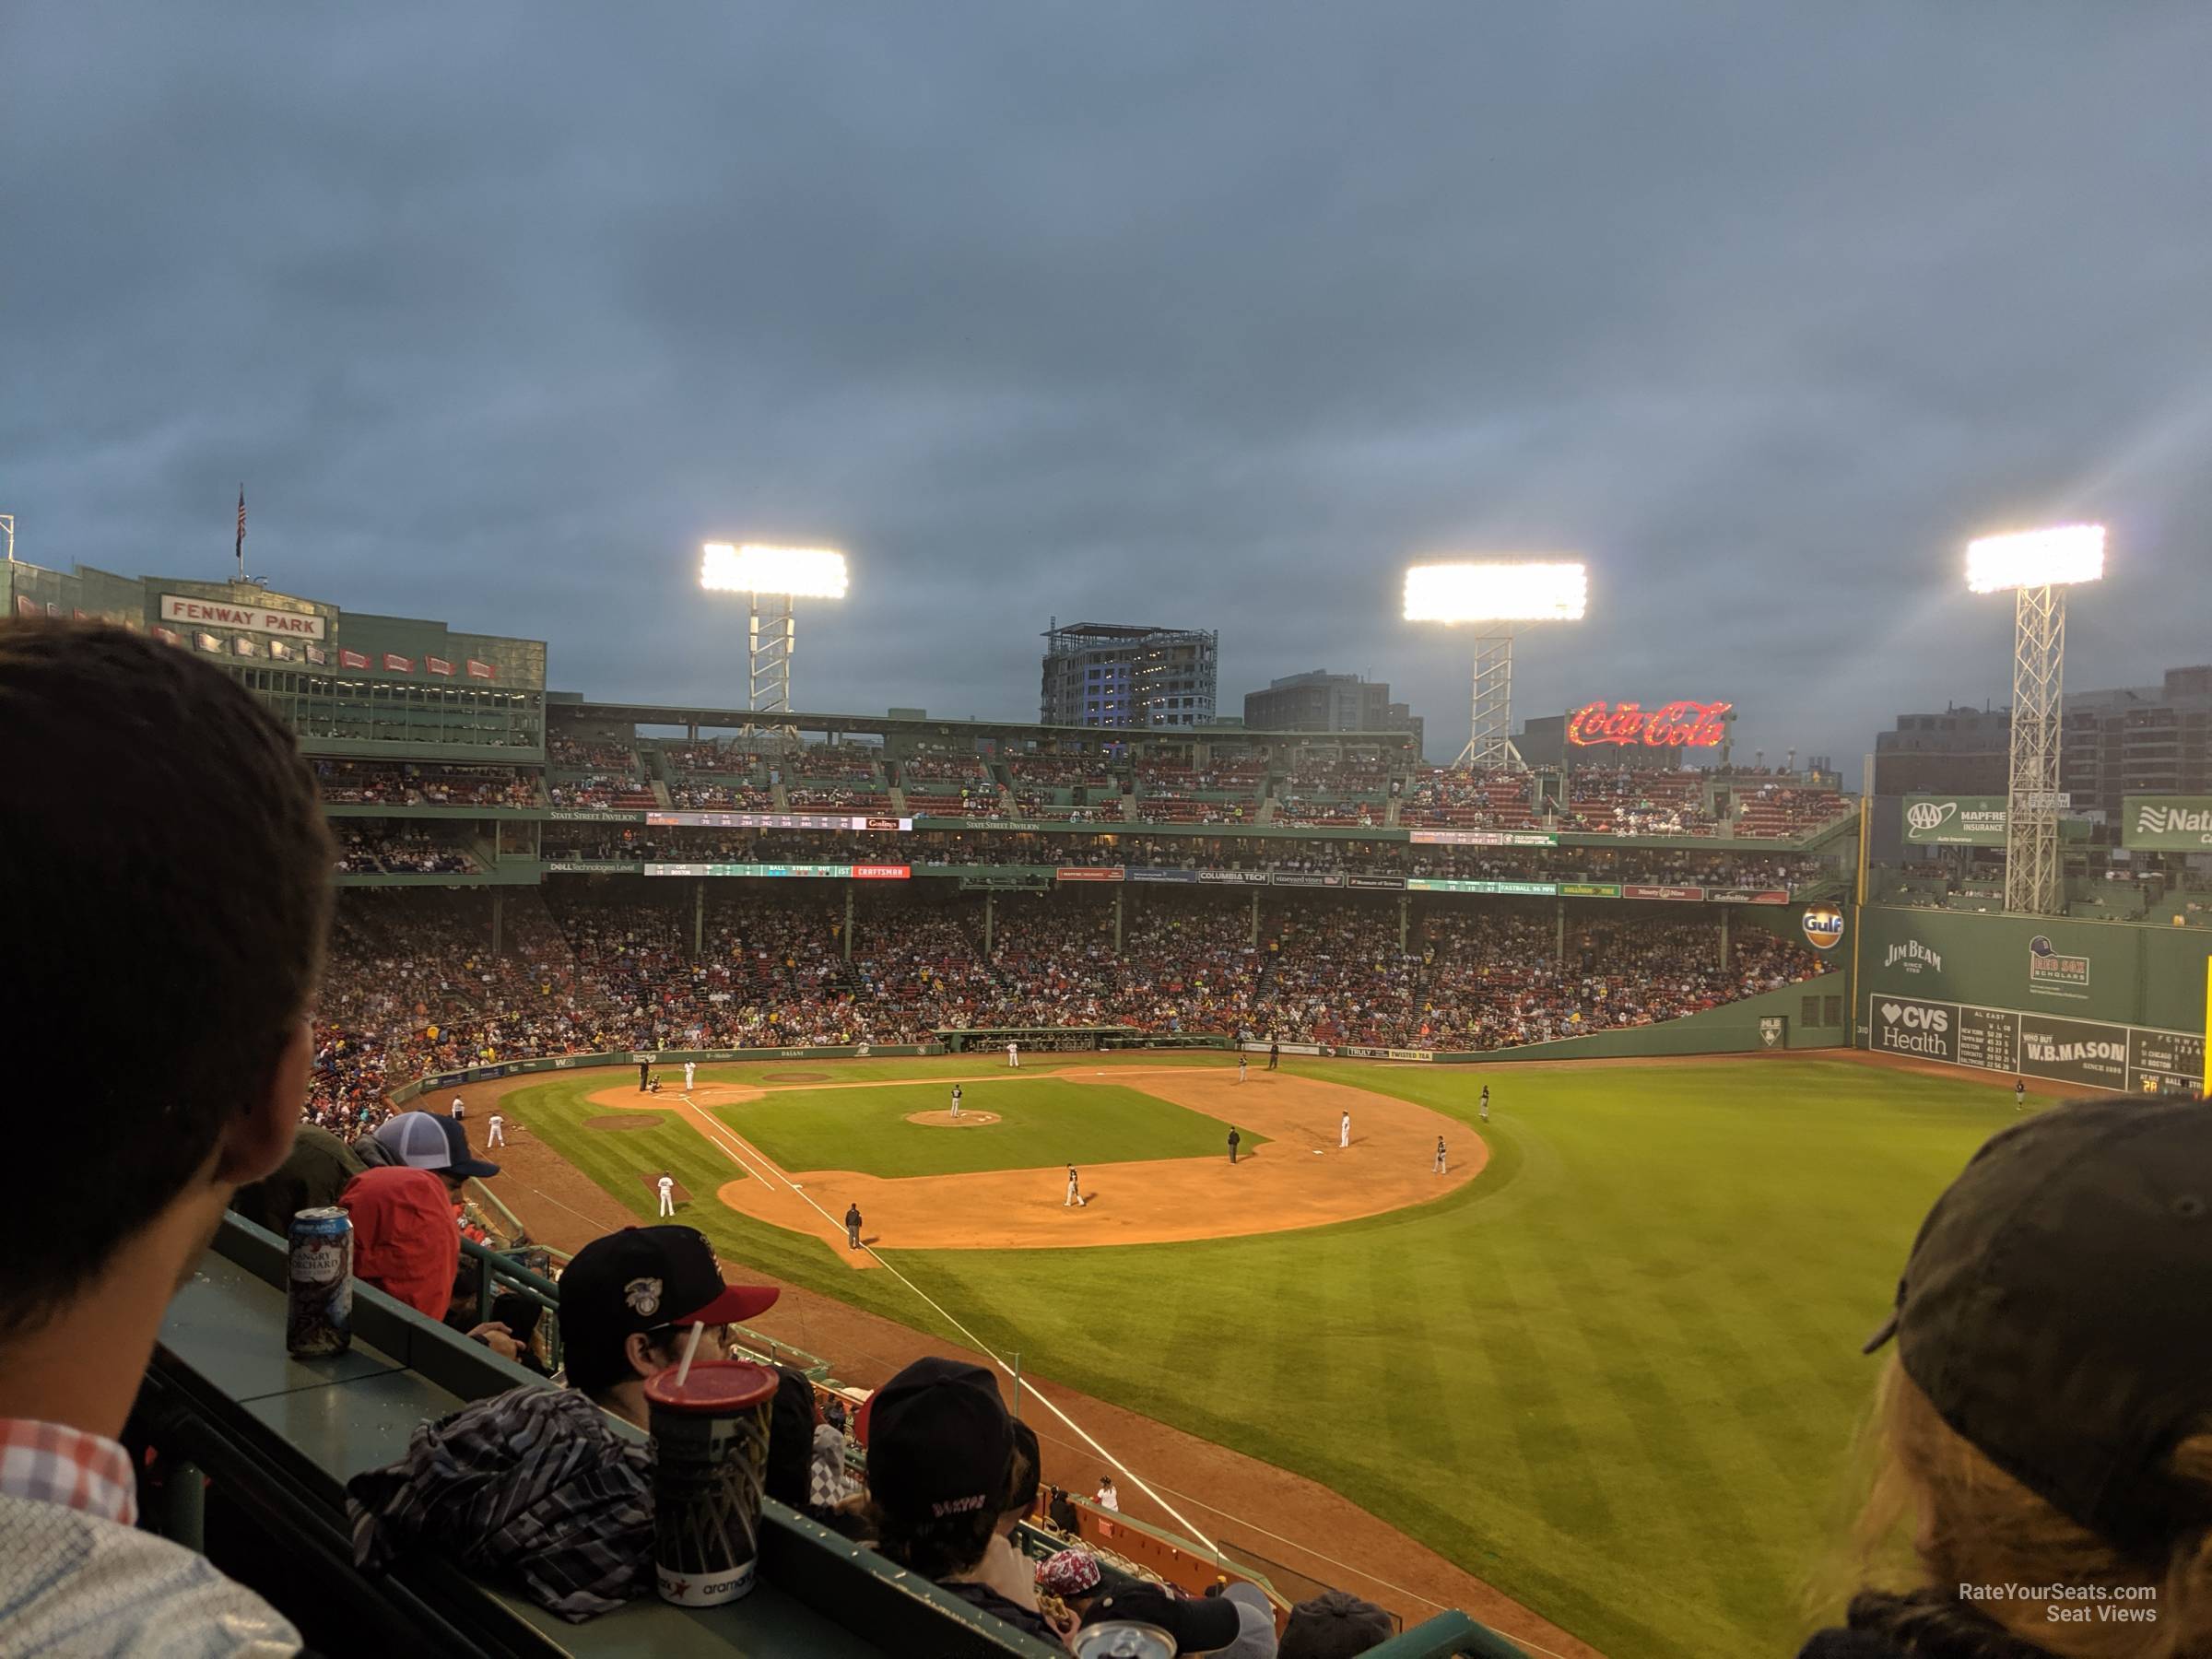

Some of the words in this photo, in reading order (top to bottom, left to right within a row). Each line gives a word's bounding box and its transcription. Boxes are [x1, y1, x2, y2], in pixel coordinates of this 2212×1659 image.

[172, 602, 254, 625] FENWAY
[265, 615, 315, 633] PARK
[550, 811, 571, 819] STATE
[573, 811, 601, 820] STREET
[602, 812, 638, 821] PAVILION
[1910, 805, 1939, 828] AAA
[1961, 811, 2006, 821] MAPFRE
[985, 821, 1008, 830] STREET
[1009, 821, 1040, 830] PAVILION
[1963, 823, 2005, 832] INSURANCE
[858, 868, 903, 877] CRAFTSMAN
[1200, 872, 1243, 880] COLUMBIA
[1244, 873, 1266, 881] TECH
[1276, 876, 1304, 884] vineyard
[1501, 884, 1531, 892] FASTBALL
[1542, 886, 1556, 894] MPH
[1713, 893, 1749, 901] Safelite
[1804, 915, 1842, 933] Gulf
[1885, 944, 1907, 967] JIM
[1909, 939, 1941, 972] BEAM
[2034, 958, 2059, 971] RED
[2061, 959, 2086, 974] SOX
[2034, 970, 2086, 981] SCHOLARS
[1902, 1006, 1948, 1032] CVS
[1985, 1012, 2006, 1020] EAST
[1882, 1026, 1947, 1055] Health
[2022, 1033, 2039, 1042] WHO
[2040, 1035, 2053, 1044] BUT
[1961, 1042, 1981, 1051] BOSTON
[2195, 1047, 2201, 1055] 4
[1350, 1047, 1371, 1056] TRULY
[1391, 1051, 1418, 1060] TWISTED
[1418, 1052, 1430, 1060] TEA
[1961, 1050, 1983, 1059] TORONTO
[2147, 1051, 2172, 1061] CHICAGO
[2083, 1062, 2104, 1072] SINCE
[2147, 1059, 2172, 1069] BOSTON
[2149, 1074, 2159, 1082] BAT
[2165, 1077, 2182, 1087] BALL
[293, 1260, 338, 1268] ORCHARD
